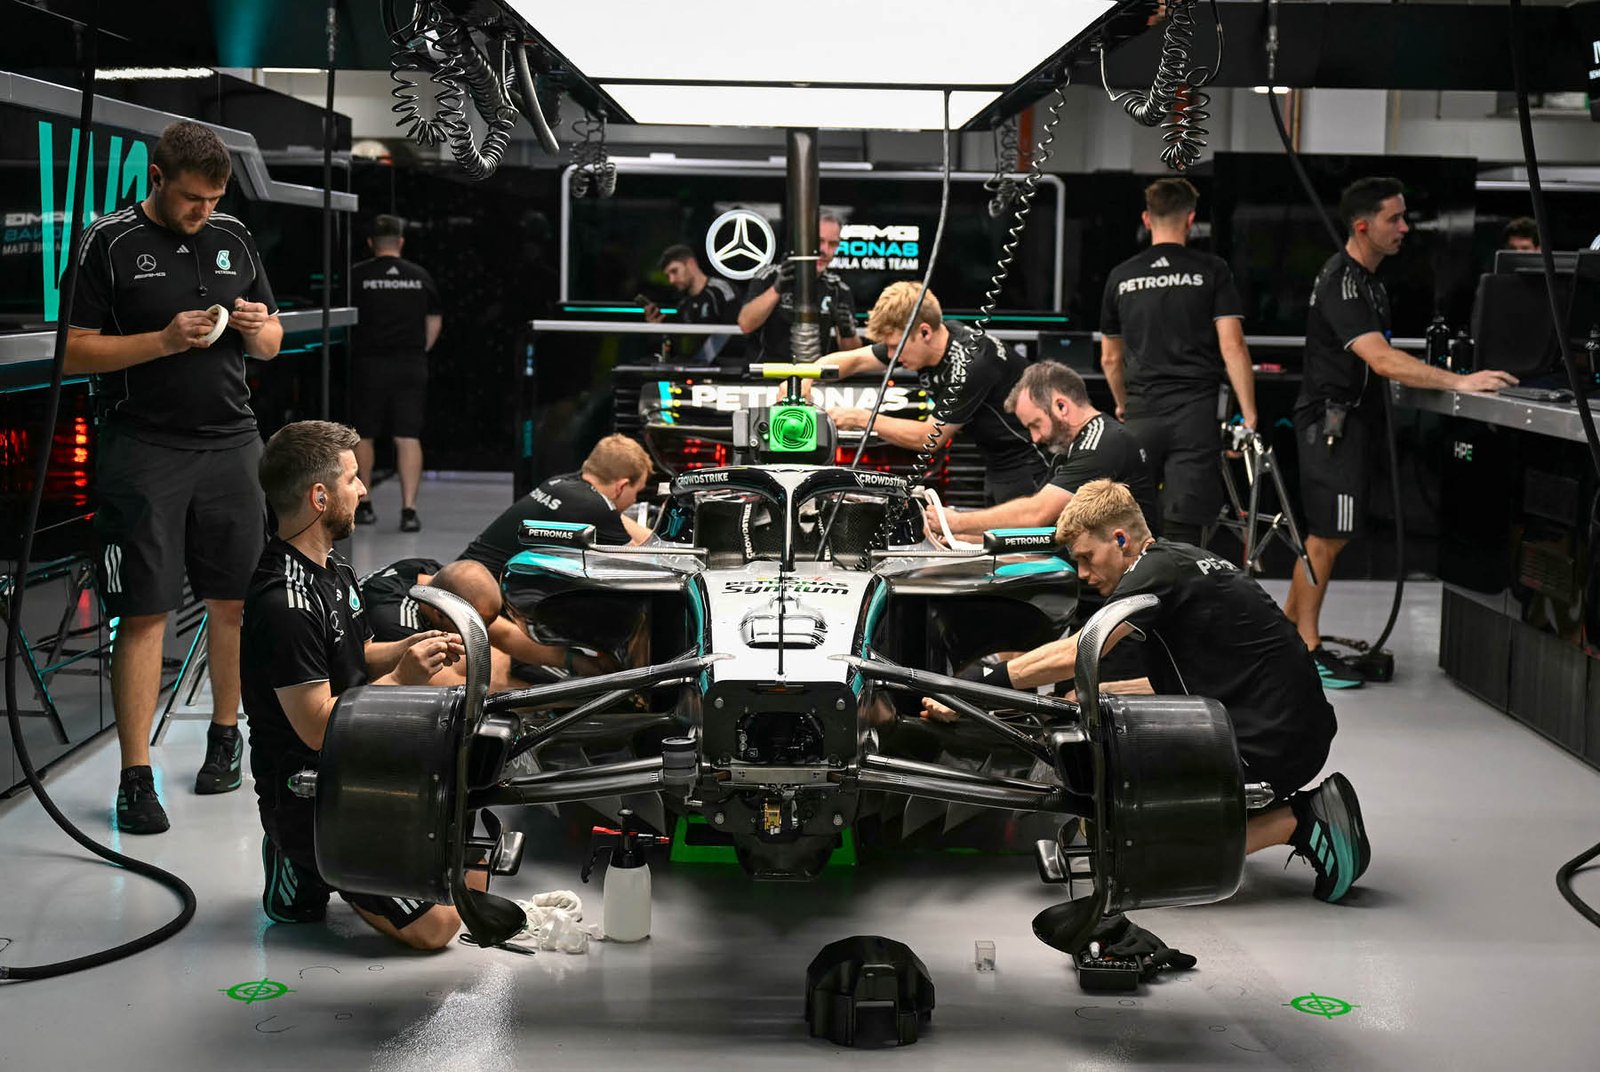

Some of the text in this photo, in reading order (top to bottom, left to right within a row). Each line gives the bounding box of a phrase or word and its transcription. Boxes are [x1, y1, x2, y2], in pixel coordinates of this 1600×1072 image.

[834, 241, 919, 257] RONAS
[861, 256, 886, 270] ONE
[887, 256, 919, 271] TEAM
[363, 279, 422, 290] PETRONAS
[1118, 273, 1204, 295] PETRONAS
[691, 385, 909, 412] PETNAS
[528, 528, 574, 540] PETRONAS
[1004, 535, 1051, 546] PETRONAS
